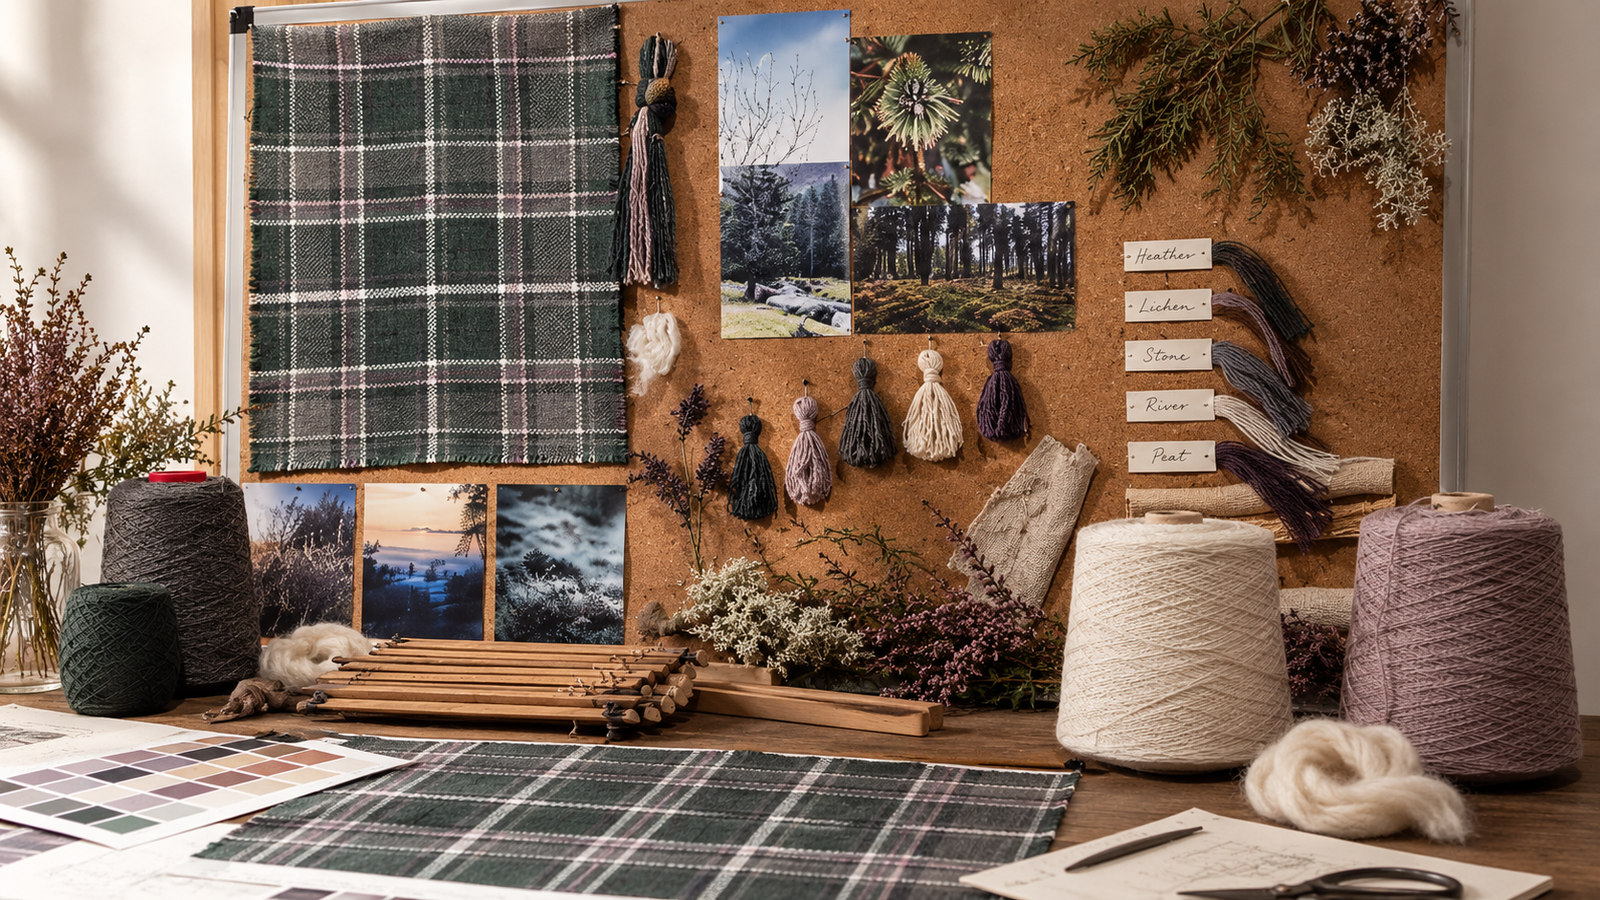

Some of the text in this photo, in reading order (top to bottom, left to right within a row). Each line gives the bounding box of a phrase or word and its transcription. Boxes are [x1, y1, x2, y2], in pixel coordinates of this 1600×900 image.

[1135, 247, 1196, 264] Heather
[1139, 298, 1195, 313] Lichen
[1143, 347, 1190, 362] Stone
[1146, 397, 1189, 411] River
[1152, 447, 1192, 464] Peat
